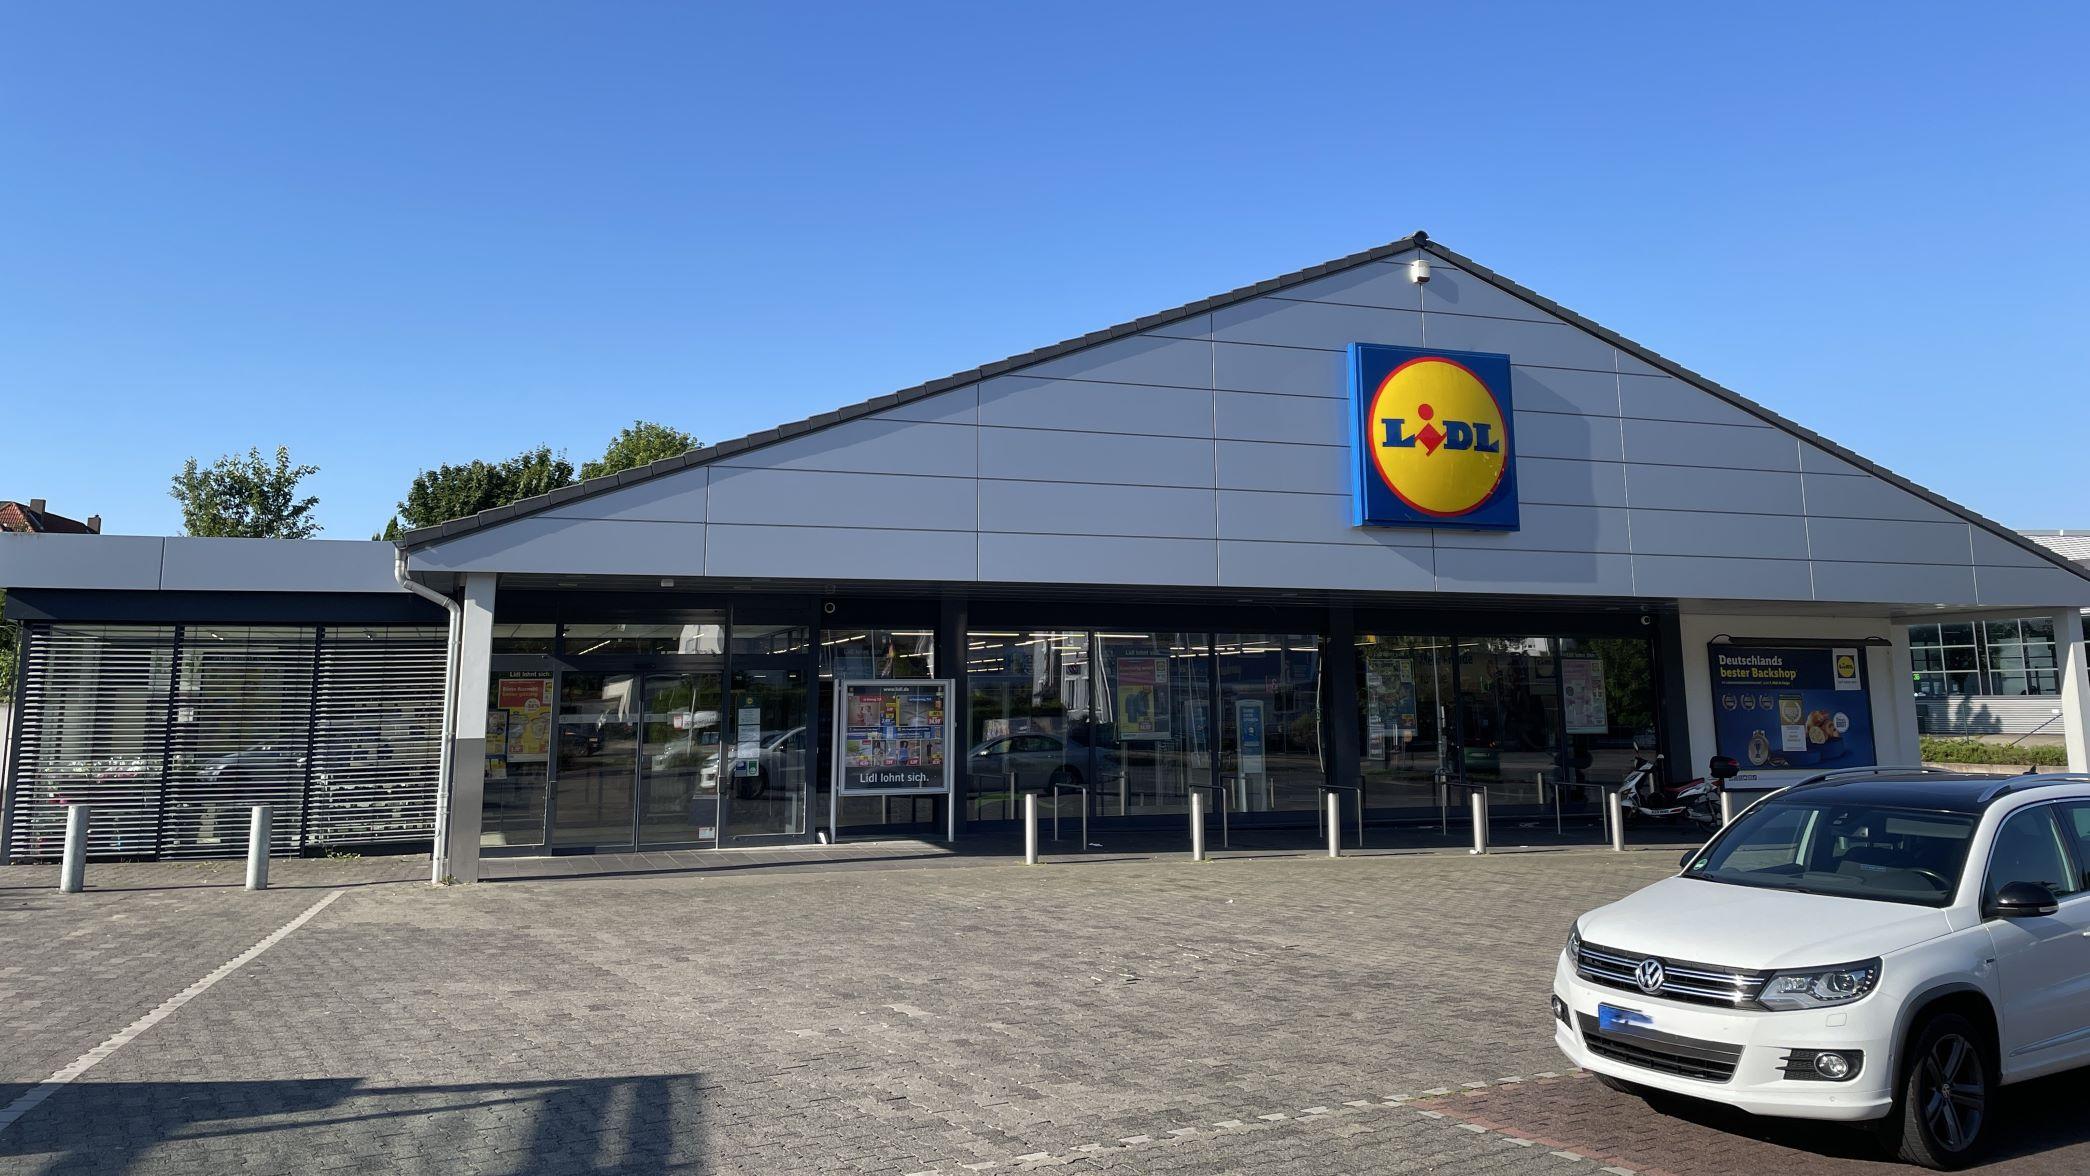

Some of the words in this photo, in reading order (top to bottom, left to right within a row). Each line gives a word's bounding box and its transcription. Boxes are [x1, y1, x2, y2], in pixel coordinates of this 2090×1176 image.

[1381, 404, 1499, 456] LIDL
[1718, 654, 1783, 666] Deutschlands
[1720, 666, 1750, 678] bester
[1751, 667, 1797, 680] Backshop
[859, 773, 878, 783] Lidl
[880, 772, 905, 783] lohnt
[907, 772, 929, 783] sich.
